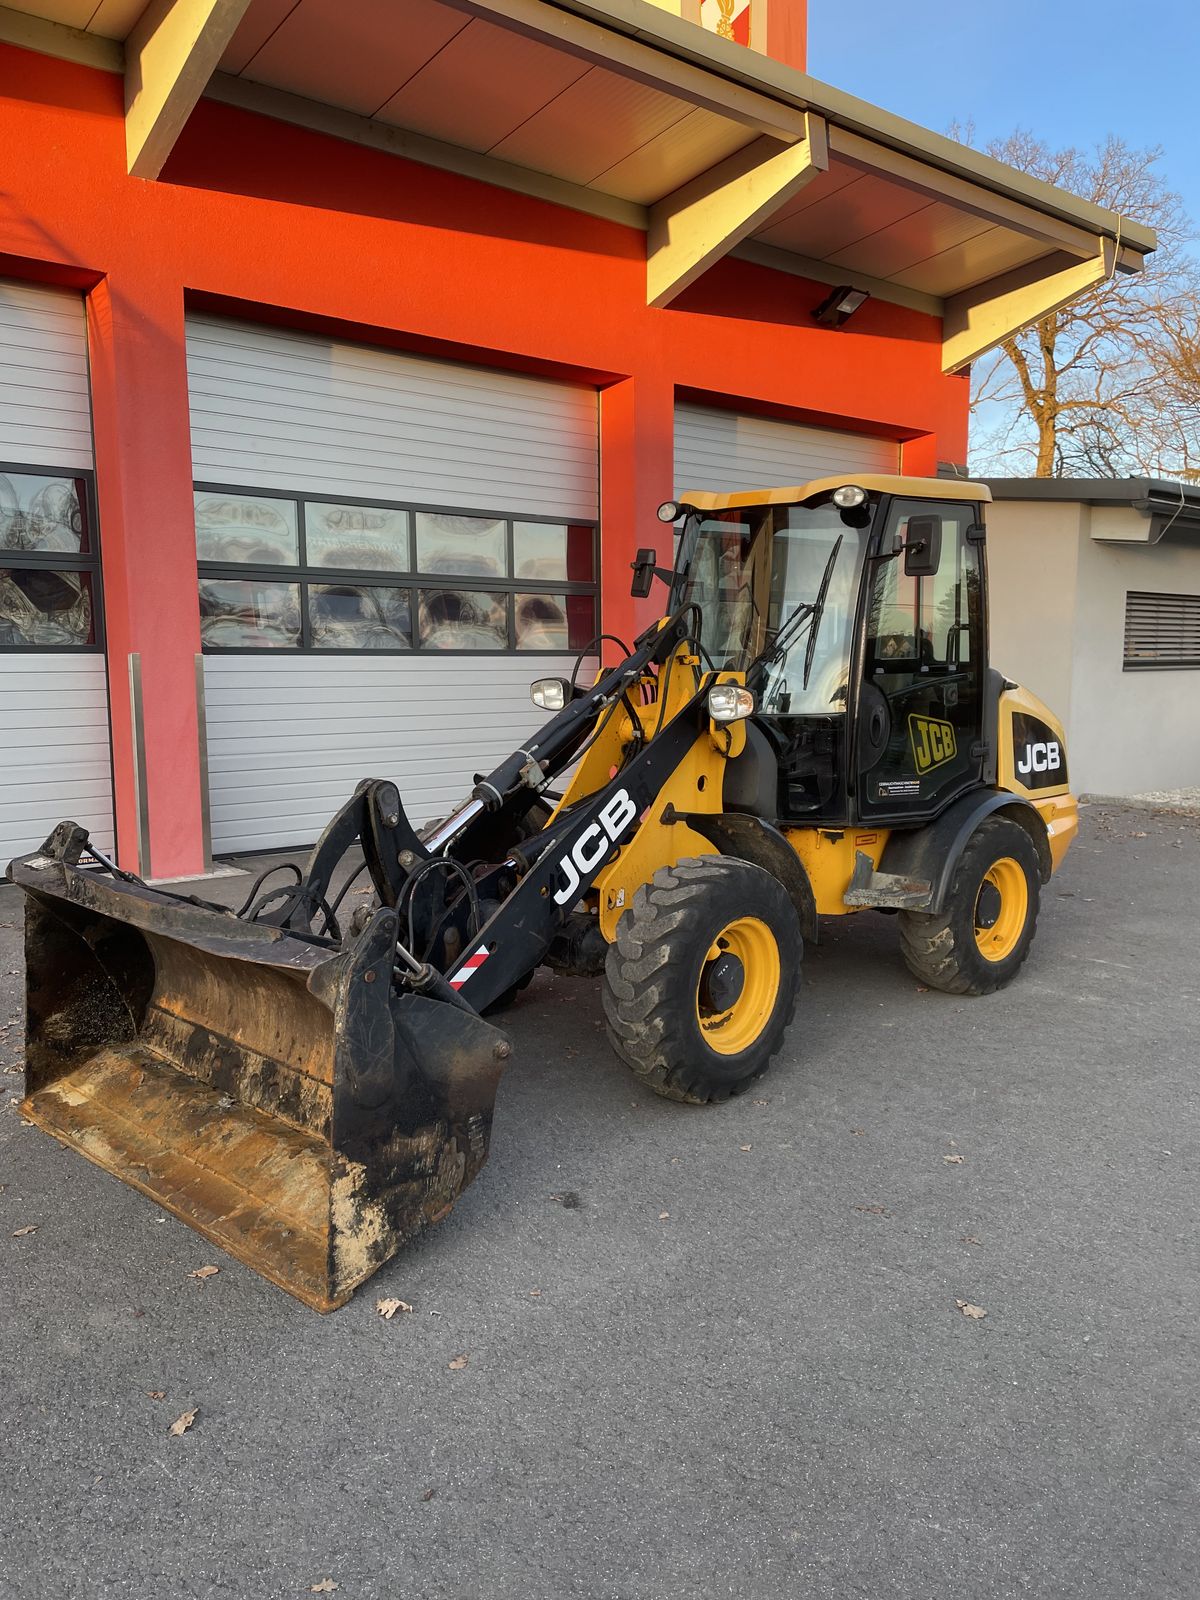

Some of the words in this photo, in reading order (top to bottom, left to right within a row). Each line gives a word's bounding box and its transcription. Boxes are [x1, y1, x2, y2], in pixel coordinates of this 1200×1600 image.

[917, 720, 954, 768] JCB
[1018, 741, 1060, 774] JCB
[553, 788, 637, 905] JCB
